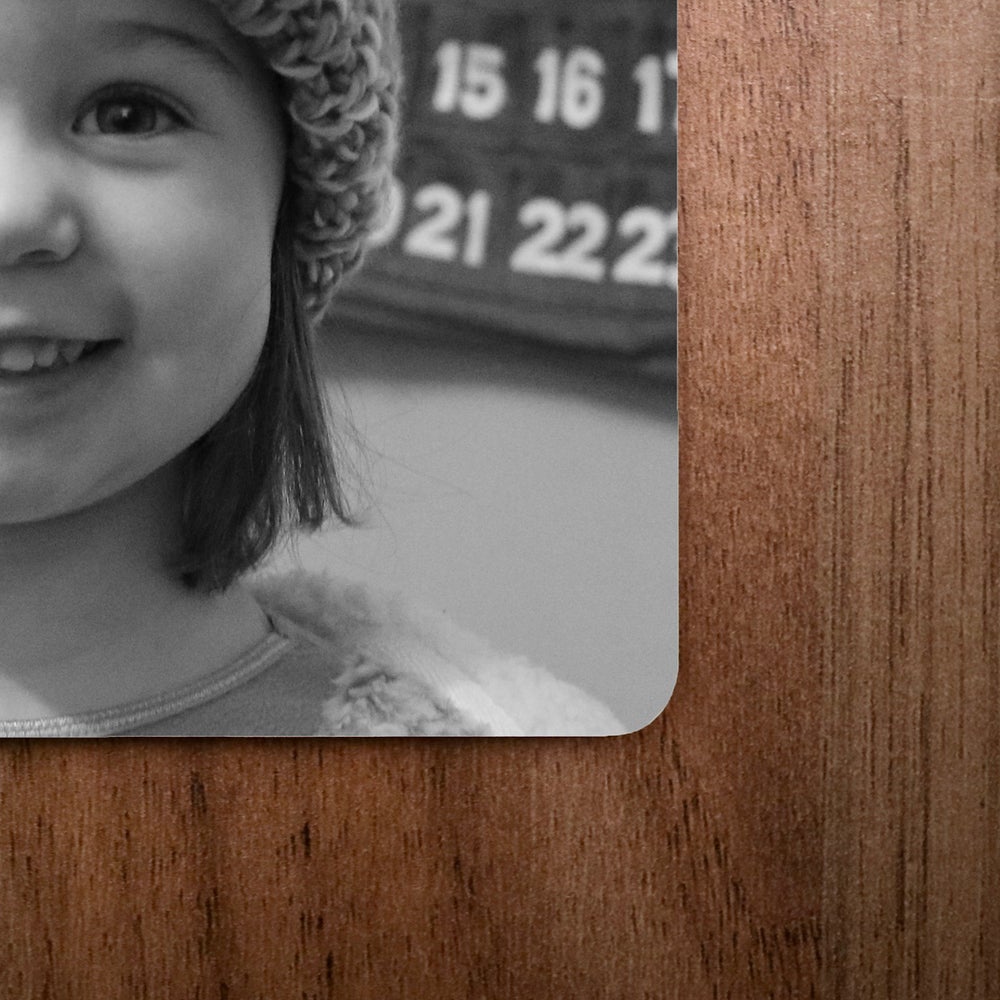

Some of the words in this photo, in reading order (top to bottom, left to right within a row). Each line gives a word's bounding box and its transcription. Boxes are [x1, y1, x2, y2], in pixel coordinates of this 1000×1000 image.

[431, 40, 507, 121] 15
[533, 47, 605, 130] 16
[634, 50, 677, 135] 1
[404, 183, 493, 269] 21
[508, 197, 609, 283] 22
[610, 205, 677, 291] 2
